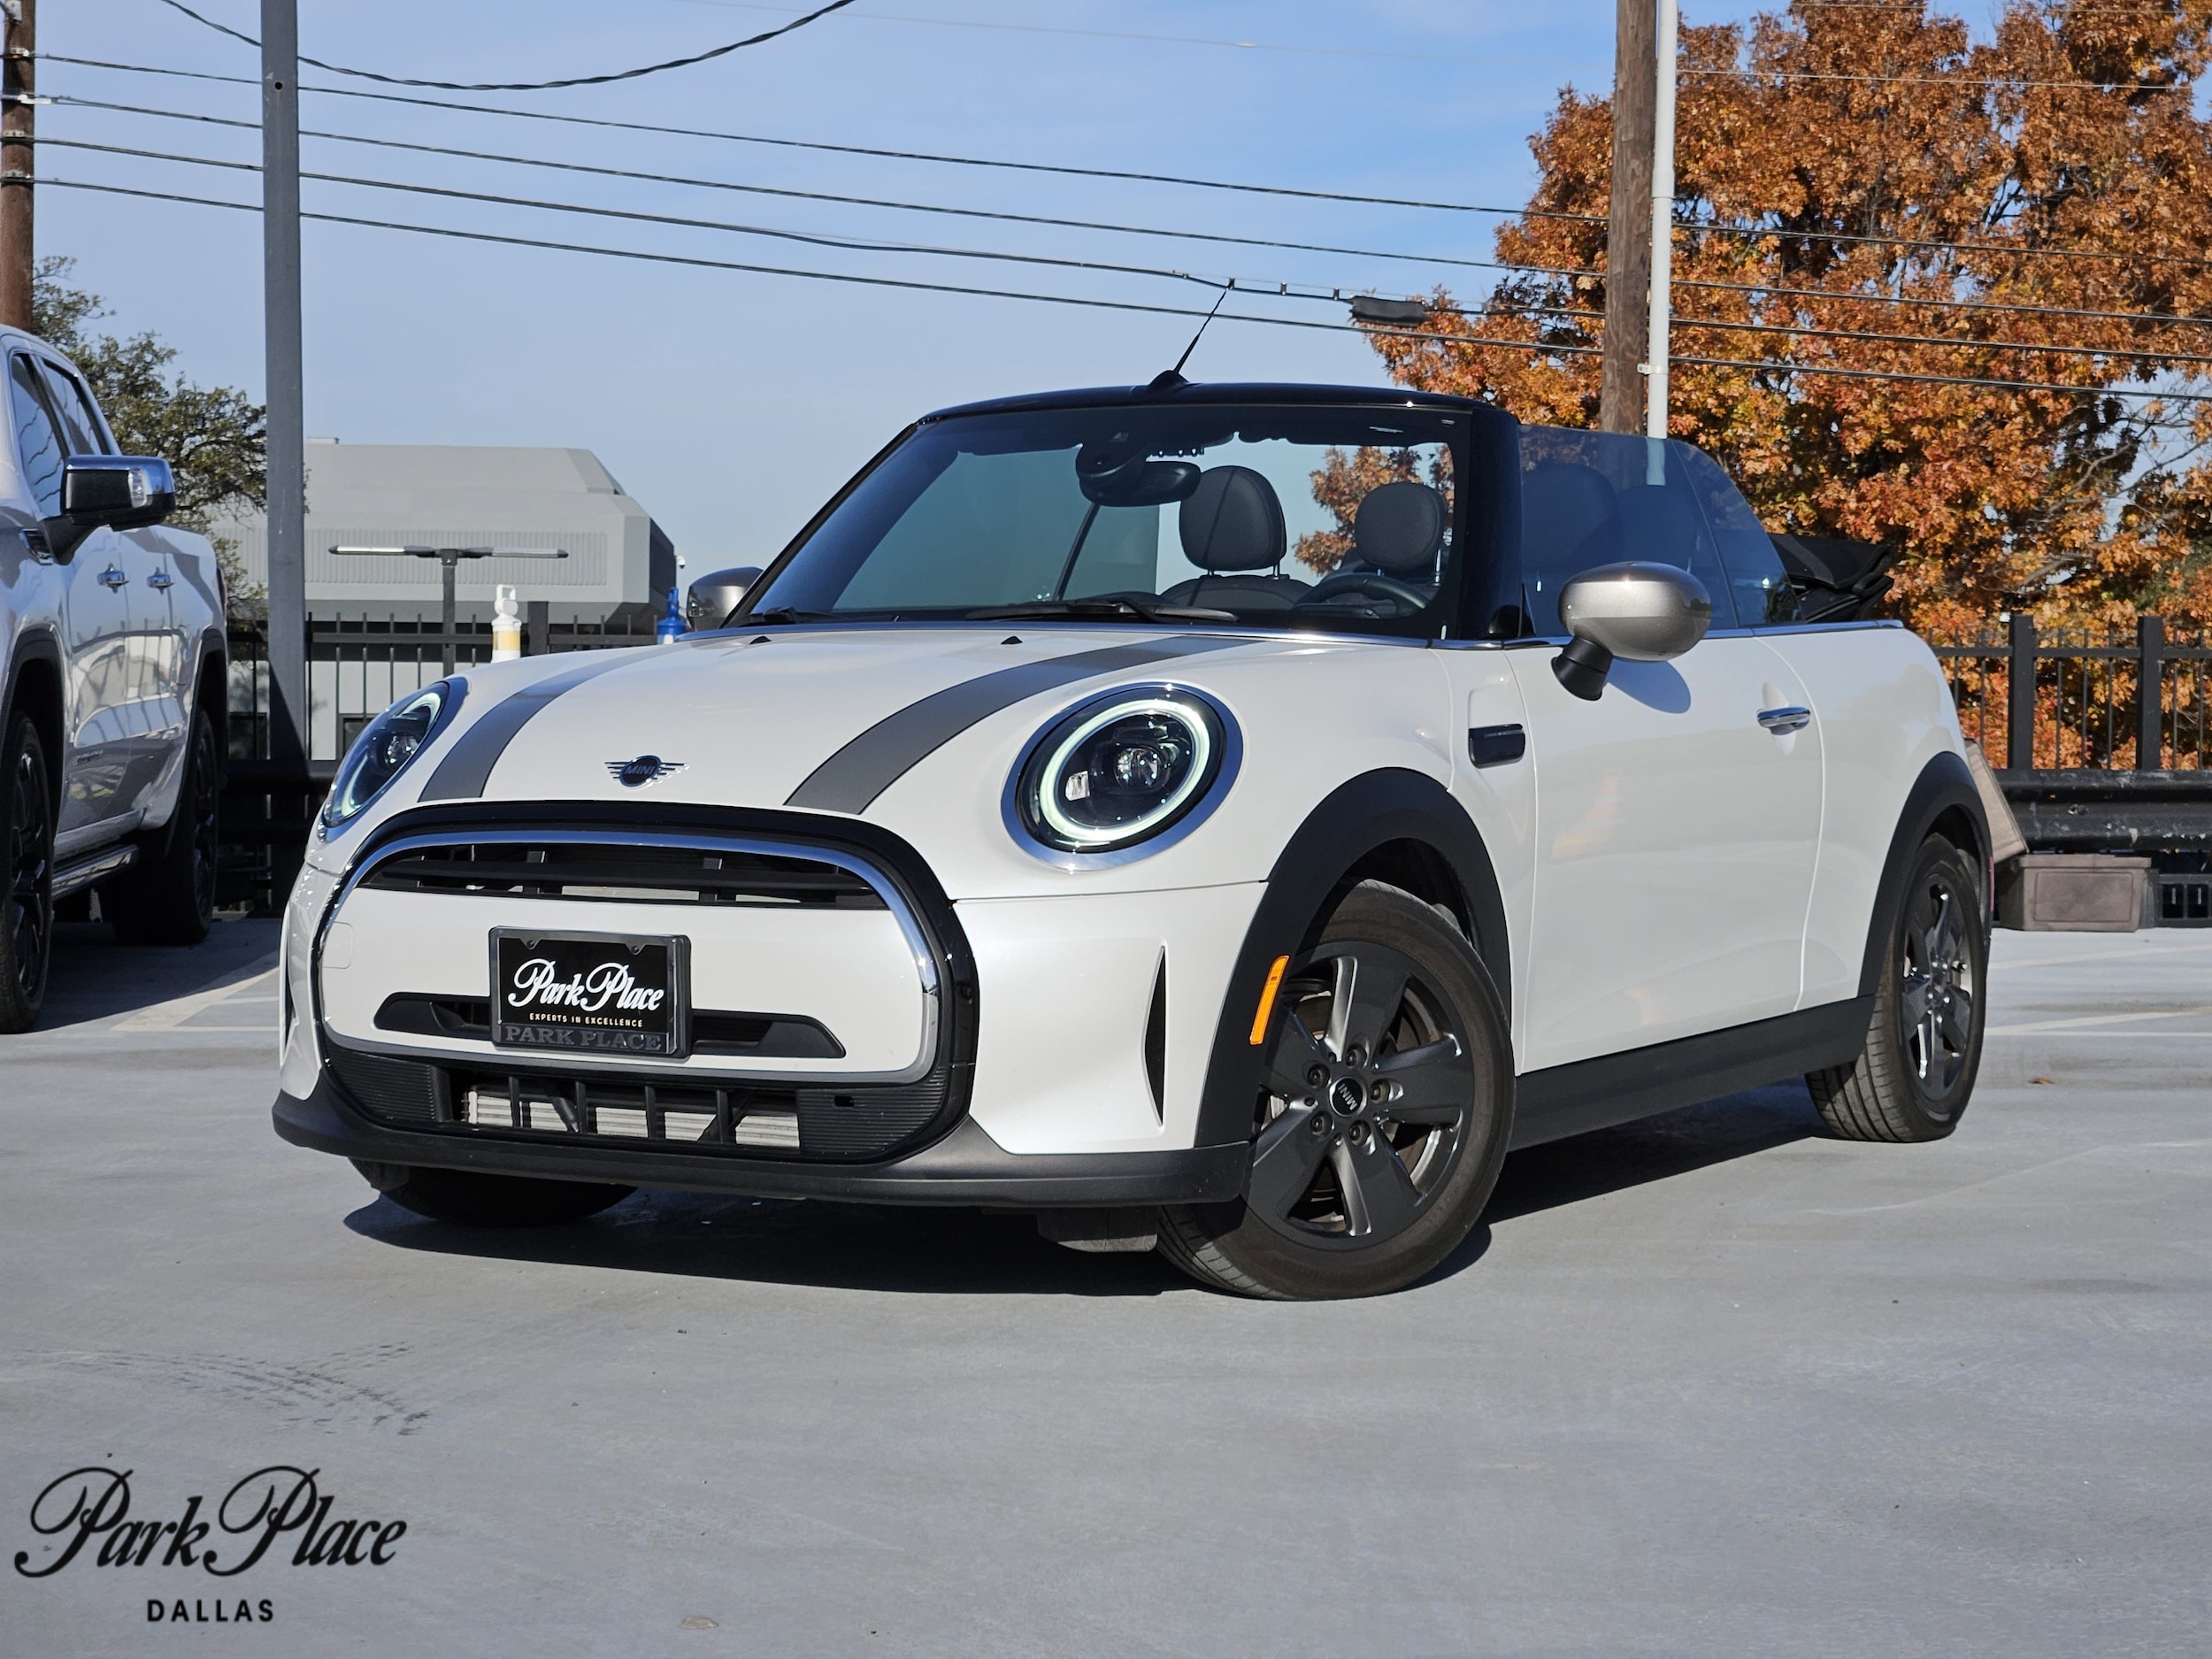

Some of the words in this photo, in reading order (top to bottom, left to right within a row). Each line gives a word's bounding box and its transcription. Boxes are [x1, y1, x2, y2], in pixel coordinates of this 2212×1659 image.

[625, 765, 656, 775] MINI
[508, 958, 585, 1007] Park
[580, 963, 664, 1012] Place
[529, 1013, 567, 1023] EXPERTS
[585, 1017, 643, 1028] EXCELLENCE
[506, 1025, 575, 1046] PARK
[580, 1030, 662, 1051] PLACE
[1337, 1083, 1358, 1111] MINI
